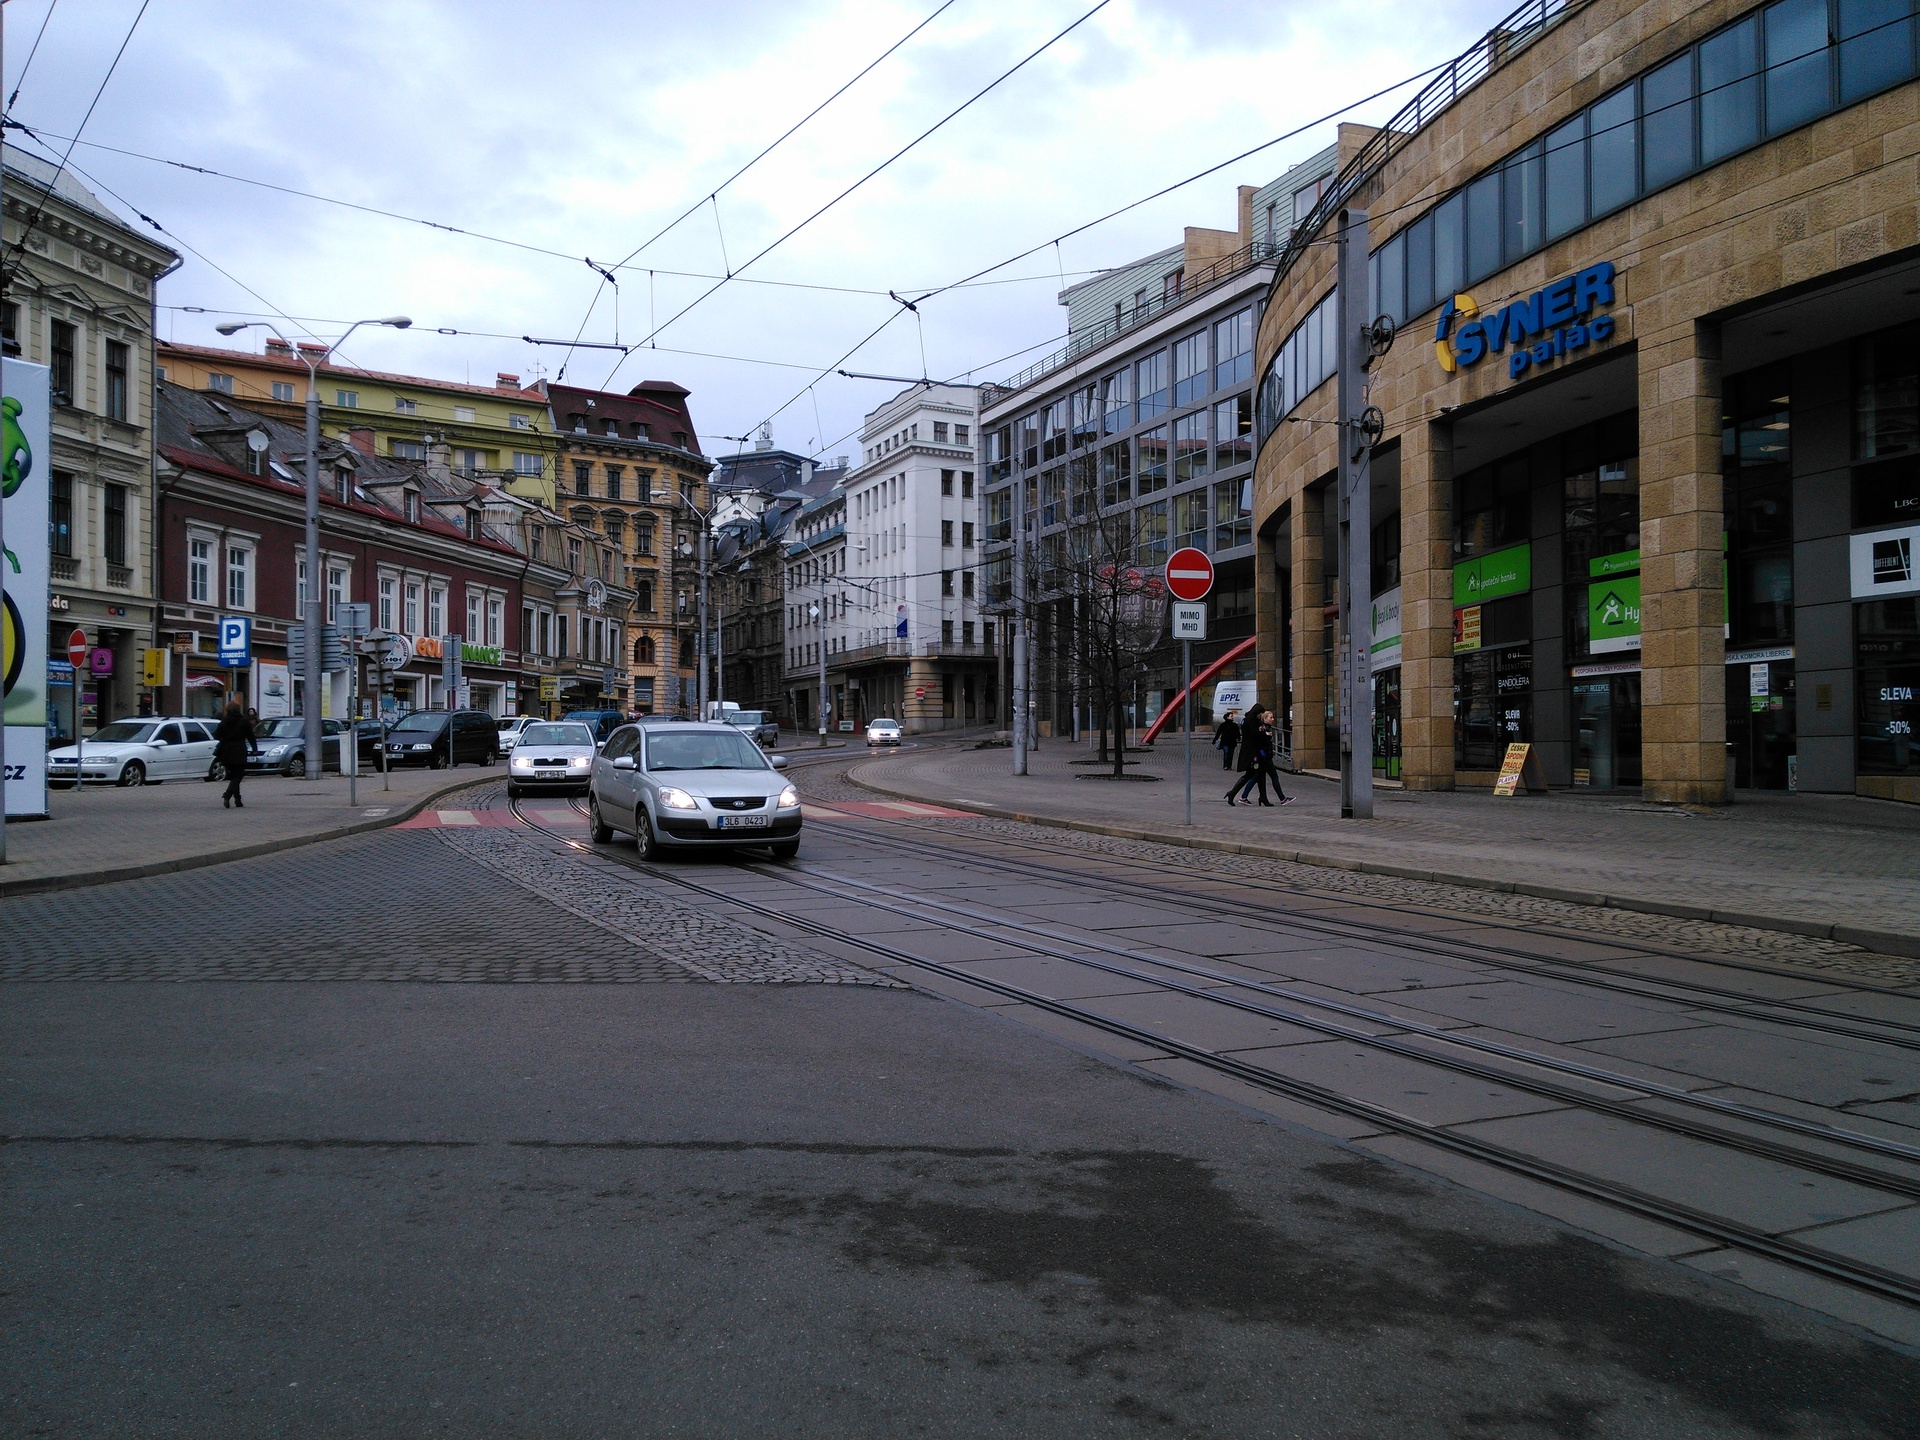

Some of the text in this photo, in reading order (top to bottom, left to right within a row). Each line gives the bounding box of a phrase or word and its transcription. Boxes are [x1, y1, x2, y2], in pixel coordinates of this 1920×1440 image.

[1455, 261, 1615, 366] SYNER
[1509, 315, 1615, 379] palác
[1894, 498, 1919, 509] LBC
[1476, 571, 1516, 590] Hypoteční banka
[1180, 611, 1200, 620] MIMO
[1181, 623, 1198, 631] MHD
[226, 624, 241, 645] P
[1740, 651, 1765, 660] KOMORA
[1766, 649, 1791, 657] LIBEREC
[1498, 676, 1530, 688] BANDOLERA
[1880, 687, 1912, 700] SLEVA
[1505, 709, 1520, 719] SLEVA
[1505, 721, 1519, 731] -50%
[1885, 721, 1911, 734] -50%
[725, 817, 764, 825] 3L6 0423
